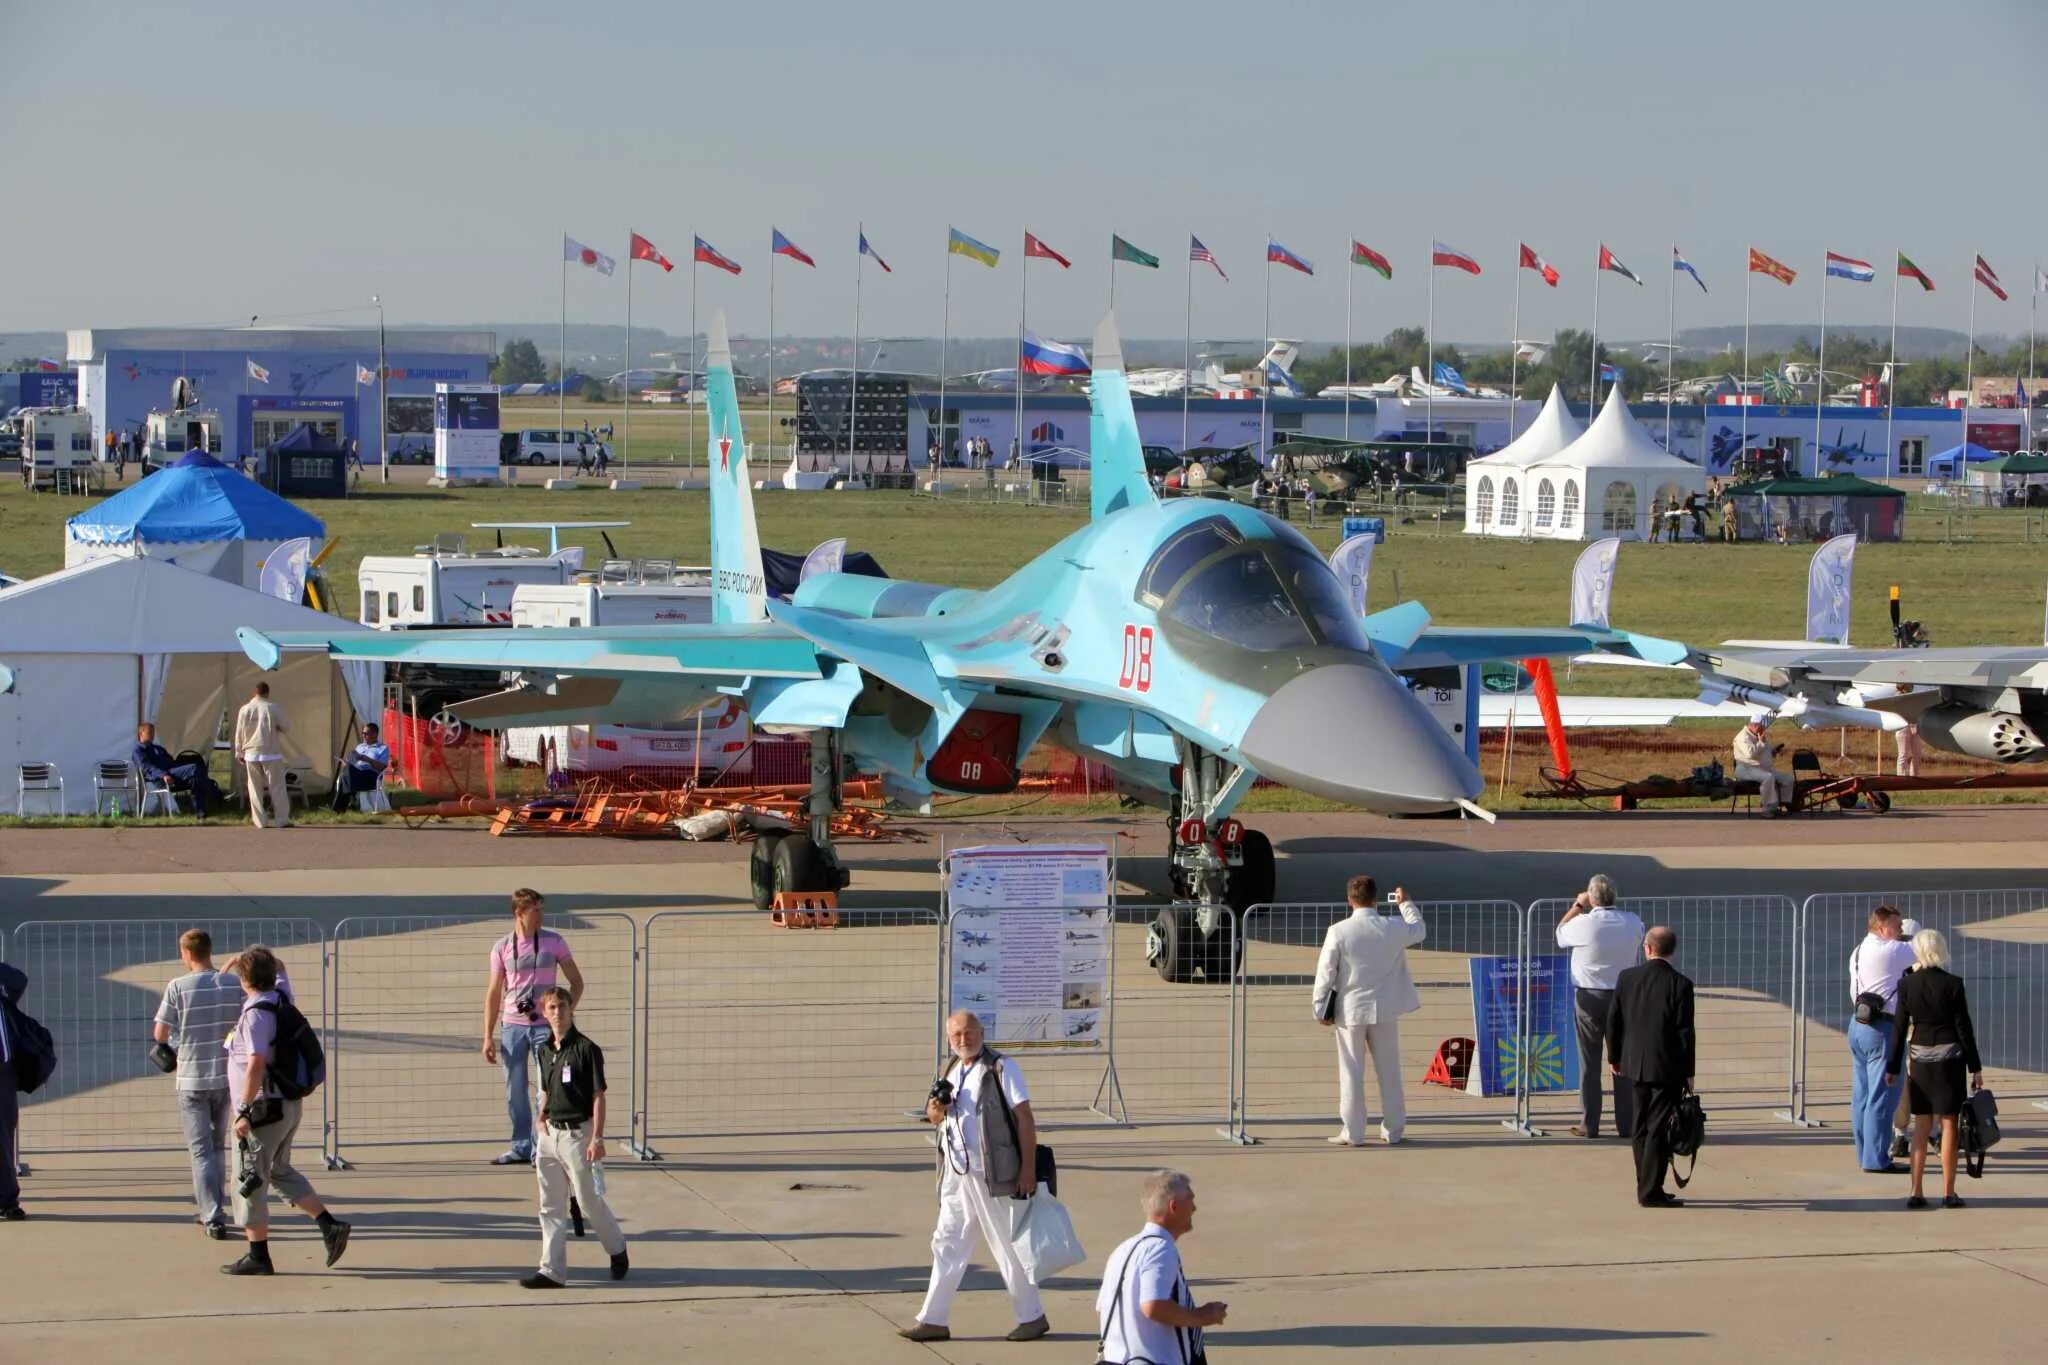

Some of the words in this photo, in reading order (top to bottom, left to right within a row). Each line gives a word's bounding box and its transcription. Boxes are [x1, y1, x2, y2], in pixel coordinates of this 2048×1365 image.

[720, 570, 731, 591] ВВС
[733, 572, 763, 595] РОССИИ
[1119, 624, 1153, 692] 08
[961, 761, 982, 780] 08
